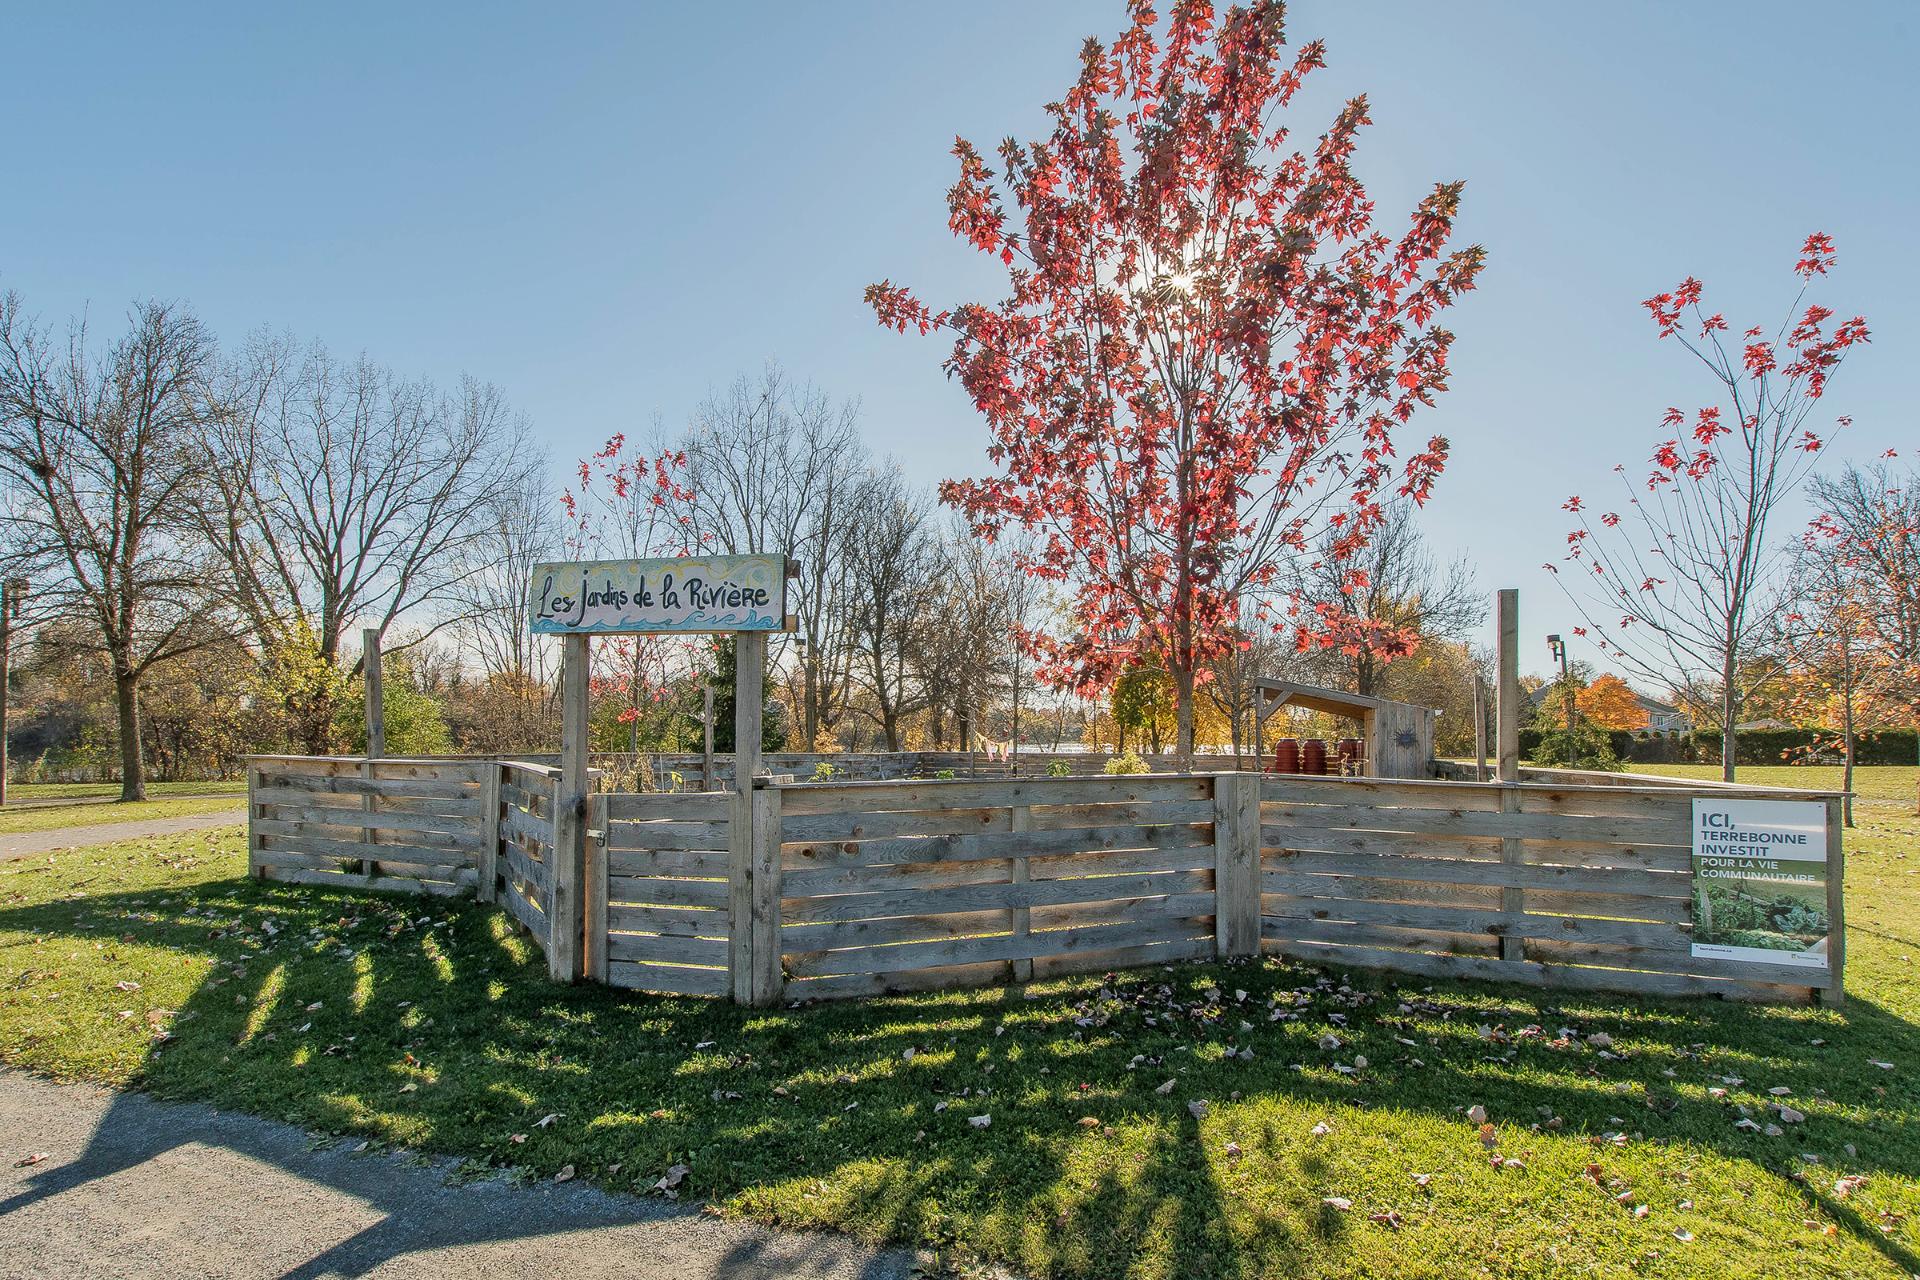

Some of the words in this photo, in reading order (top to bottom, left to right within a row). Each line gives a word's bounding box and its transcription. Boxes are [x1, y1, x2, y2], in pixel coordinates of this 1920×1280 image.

[536, 575, 576, 619] Les
[633, 575, 654, 609] de
[659, 573, 682, 610] la
[1702, 812, 1736, 830] ICI,
[1701, 831, 1807, 845] TERREBONNE
[1701, 844, 1770, 857] INVESTIT
[1700, 858, 1736, 868] POUR
[1739, 859, 1755, 869] LA
[1758, 860, 1779, 870] VIE
[1700, 870, 1816, 883] COMMUNAUTAIRE
